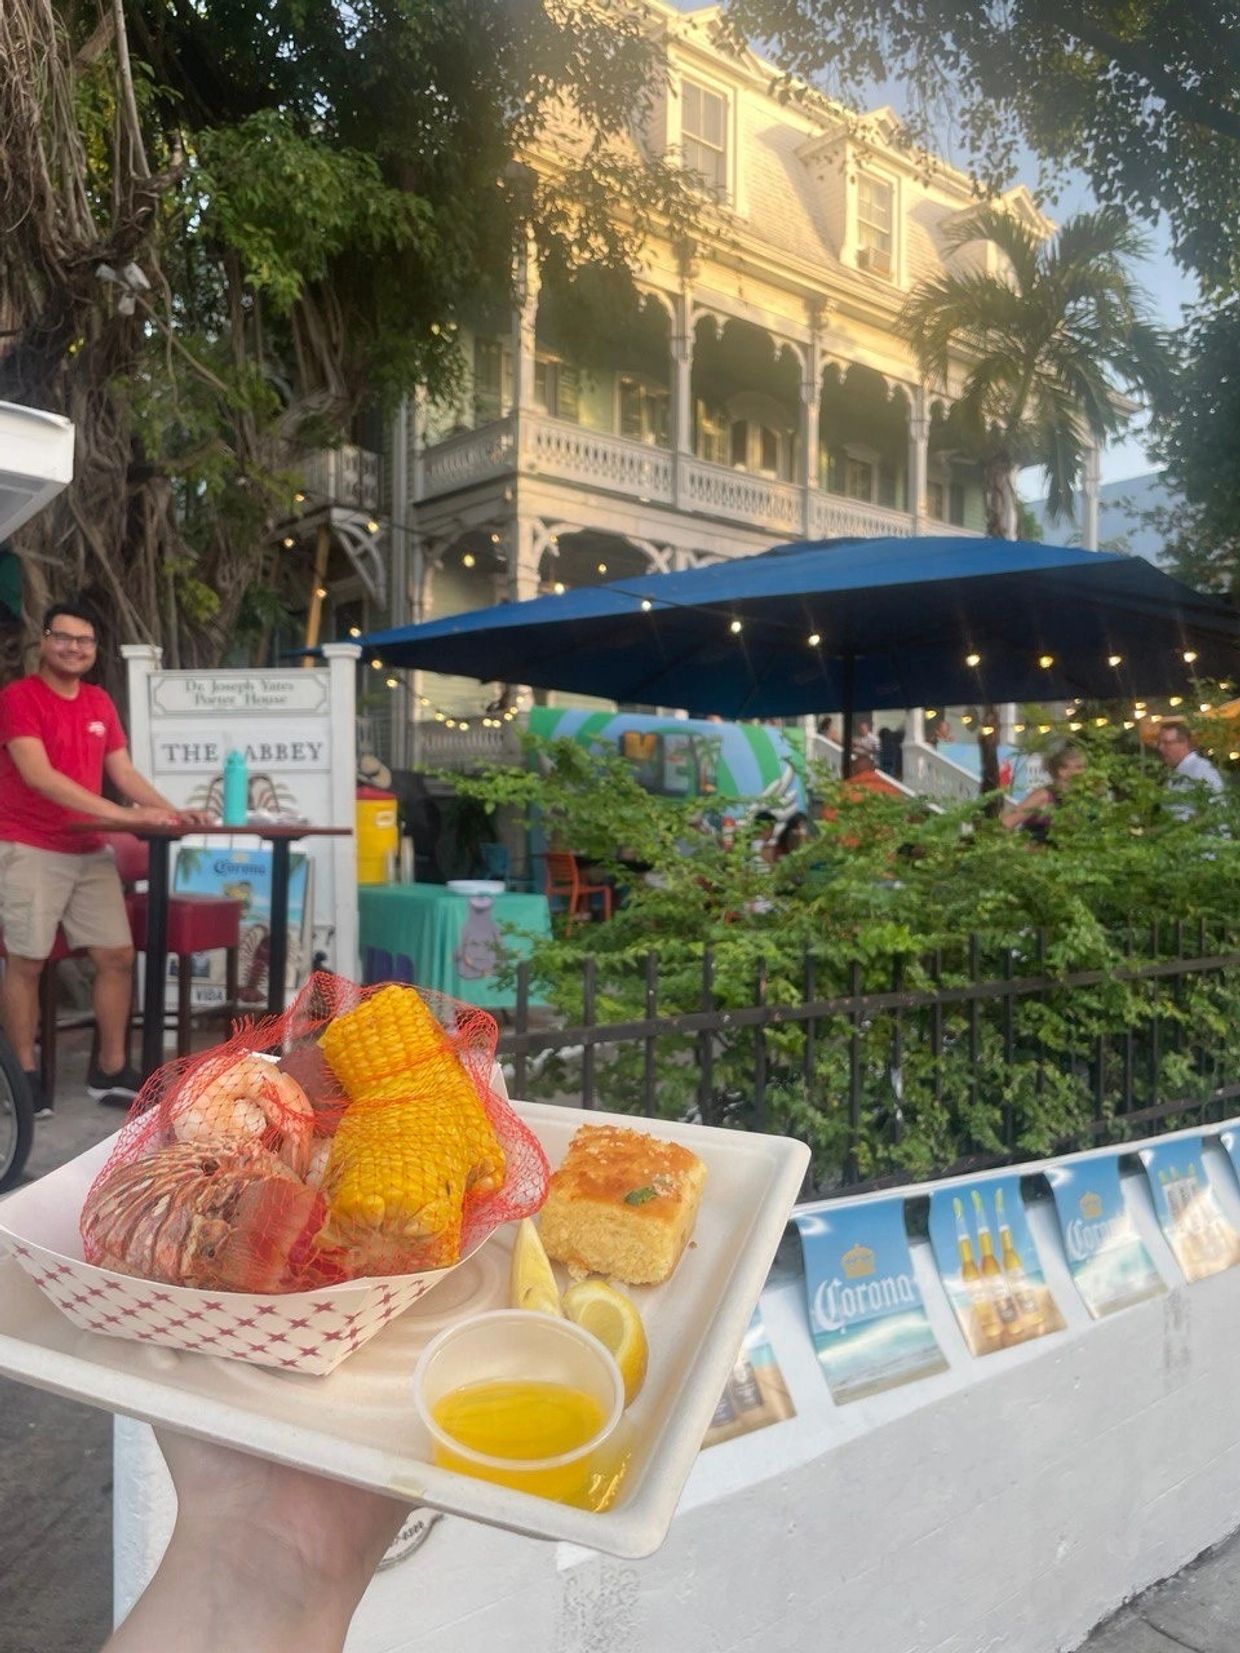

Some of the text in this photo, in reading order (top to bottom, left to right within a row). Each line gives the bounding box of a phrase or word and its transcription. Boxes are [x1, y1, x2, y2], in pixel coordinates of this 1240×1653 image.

[211, 678, 254, 695] Joseph
[244, 692, 288, 706] House
[161, 740, 323, 763] THE ABBEY
[213, 859, 267, 876] Corona
[813, 1273, 915, 1334] Corona
